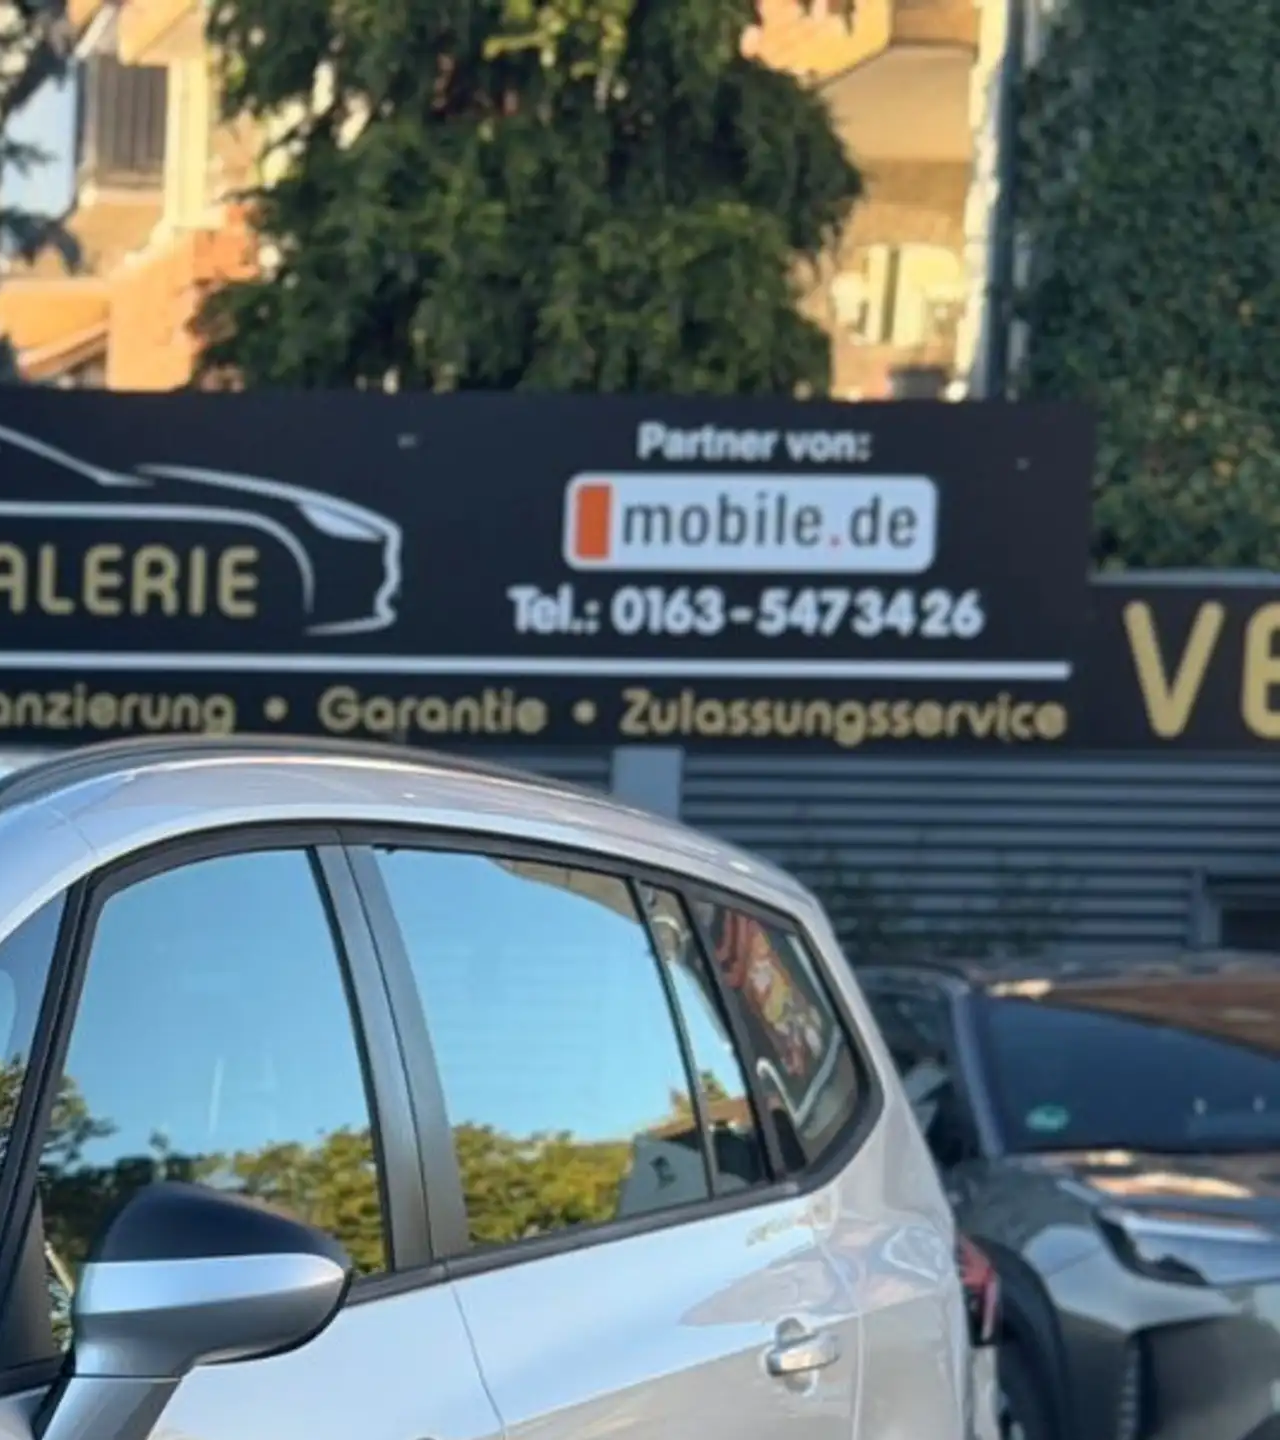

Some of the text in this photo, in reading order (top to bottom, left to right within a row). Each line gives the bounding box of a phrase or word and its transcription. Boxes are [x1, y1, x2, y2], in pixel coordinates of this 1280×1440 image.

[639, 421, 873, 462] Partner von:
[622, 493, 918, 548] mobile.de
[507, 585, 985, 639] Tel.: 0163-5473426
[318, 686, 548, 734] Garantie
[620, 689, 1067, 747] Zulassungsservice
